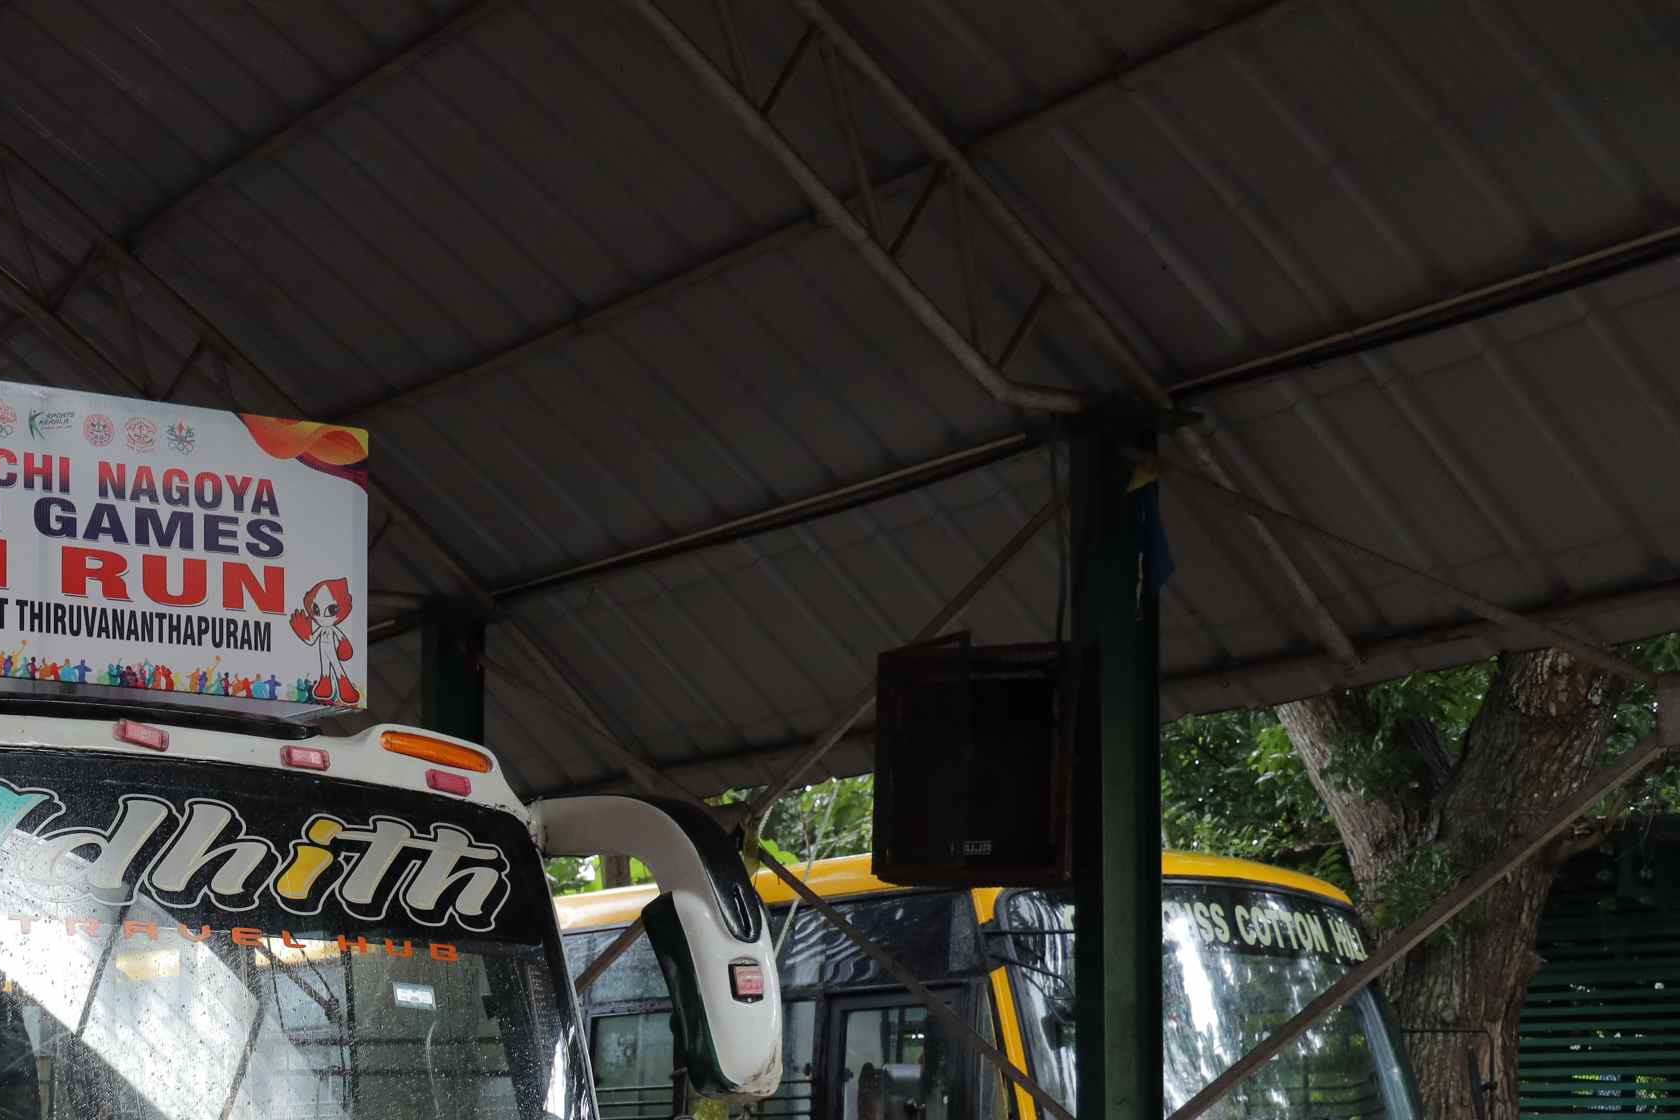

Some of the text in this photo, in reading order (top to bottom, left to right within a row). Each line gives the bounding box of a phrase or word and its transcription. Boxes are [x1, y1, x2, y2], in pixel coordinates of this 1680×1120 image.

[97, 460, 280, 517] NAGOYA
[33, 495, 286, 560] GAMES
[60, 545, 288, 617] RUN
[15, 598, 272, 653] THIRUVANANTHAPURAM
[14, 916, 458, 961] TRAVEL HUB
[1234, 904, 1329, 953] COTTON
